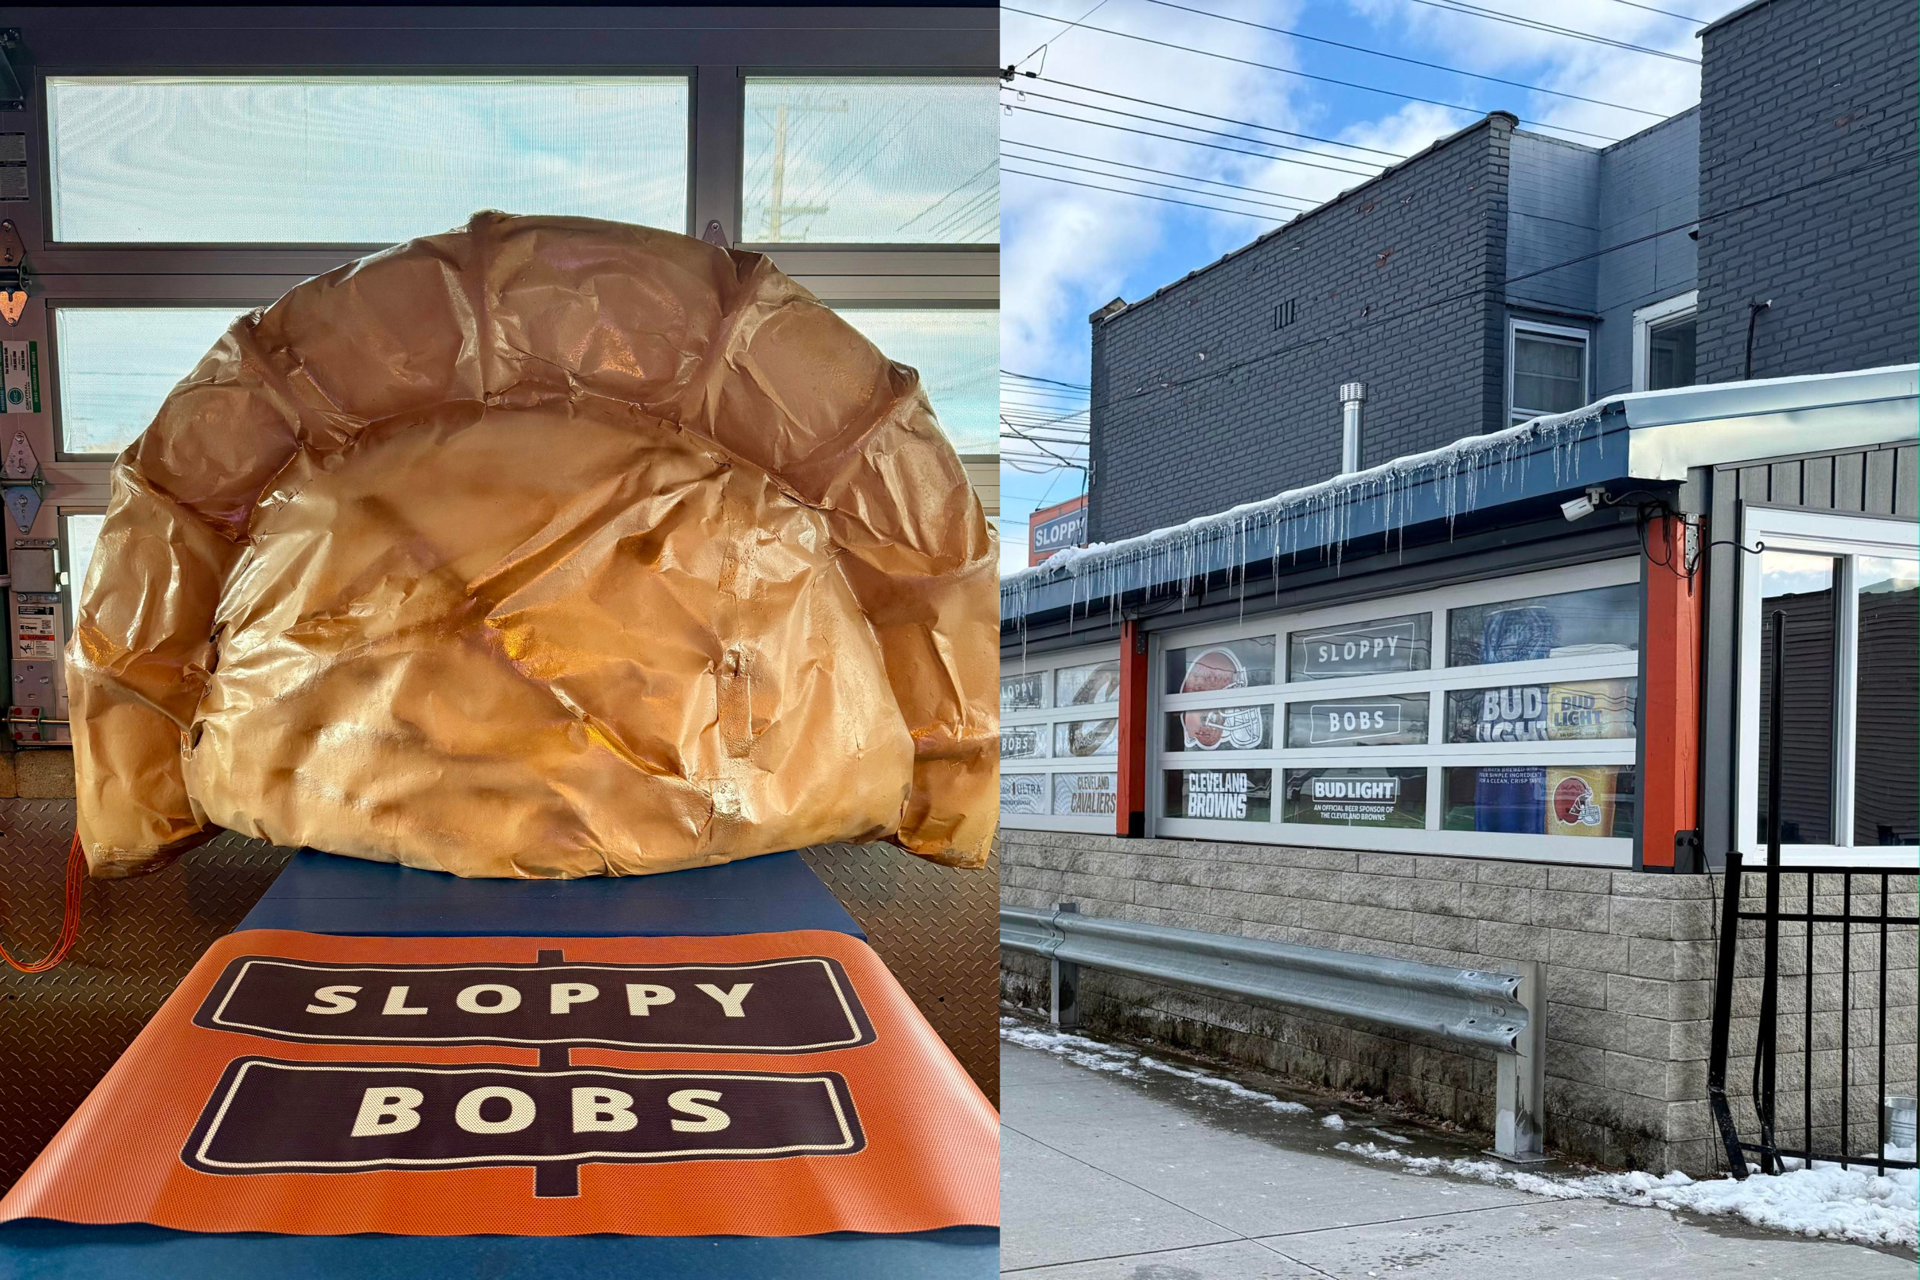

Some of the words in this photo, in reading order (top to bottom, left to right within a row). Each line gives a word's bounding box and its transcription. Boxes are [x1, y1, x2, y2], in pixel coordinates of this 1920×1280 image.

[1035, 516, 1086, 547] SLOPPY
[1318, 635, 1399, 663] SLOPPY
[1000, 681, 1034, 699] LOPPY
[1483, 687, 1542, 721] BUD
[1561, 695, 1596, 711] BUD
[1329, 711, 1384, 732] BOBS
[1554, 710, 1602, 727] LIGHT
[1001, 737, 1028, 752] BOBS
[1017, 784, 1042, 795] ULTRA
[1077, 776, 1110, 790] CLEVELAND
[1188, 772, 1248, 793] CLEVELAND
[1314, 782, 1346, 798] BUD
[1347, 782, 1394, 799] LIGHT
[1071, 793, 1117, 814] CAVALIERS
[1187, 792, 1248, 819] BROWNS
[1321, 804, 1344, 812] OFFICIAL
[1344, 805, 1359, 813] BEER
[1359, 805, 1385, 813] SPONSOR
[1385, 806, 1395, 814] OF
[1330, 812, 1360, 820] CLEVELAND
[1360, 813, 1386, 821] BROWNS
[305, 982, 754, 1018] SLOPPY
[350, 1086, 731, 1138] BOBS
